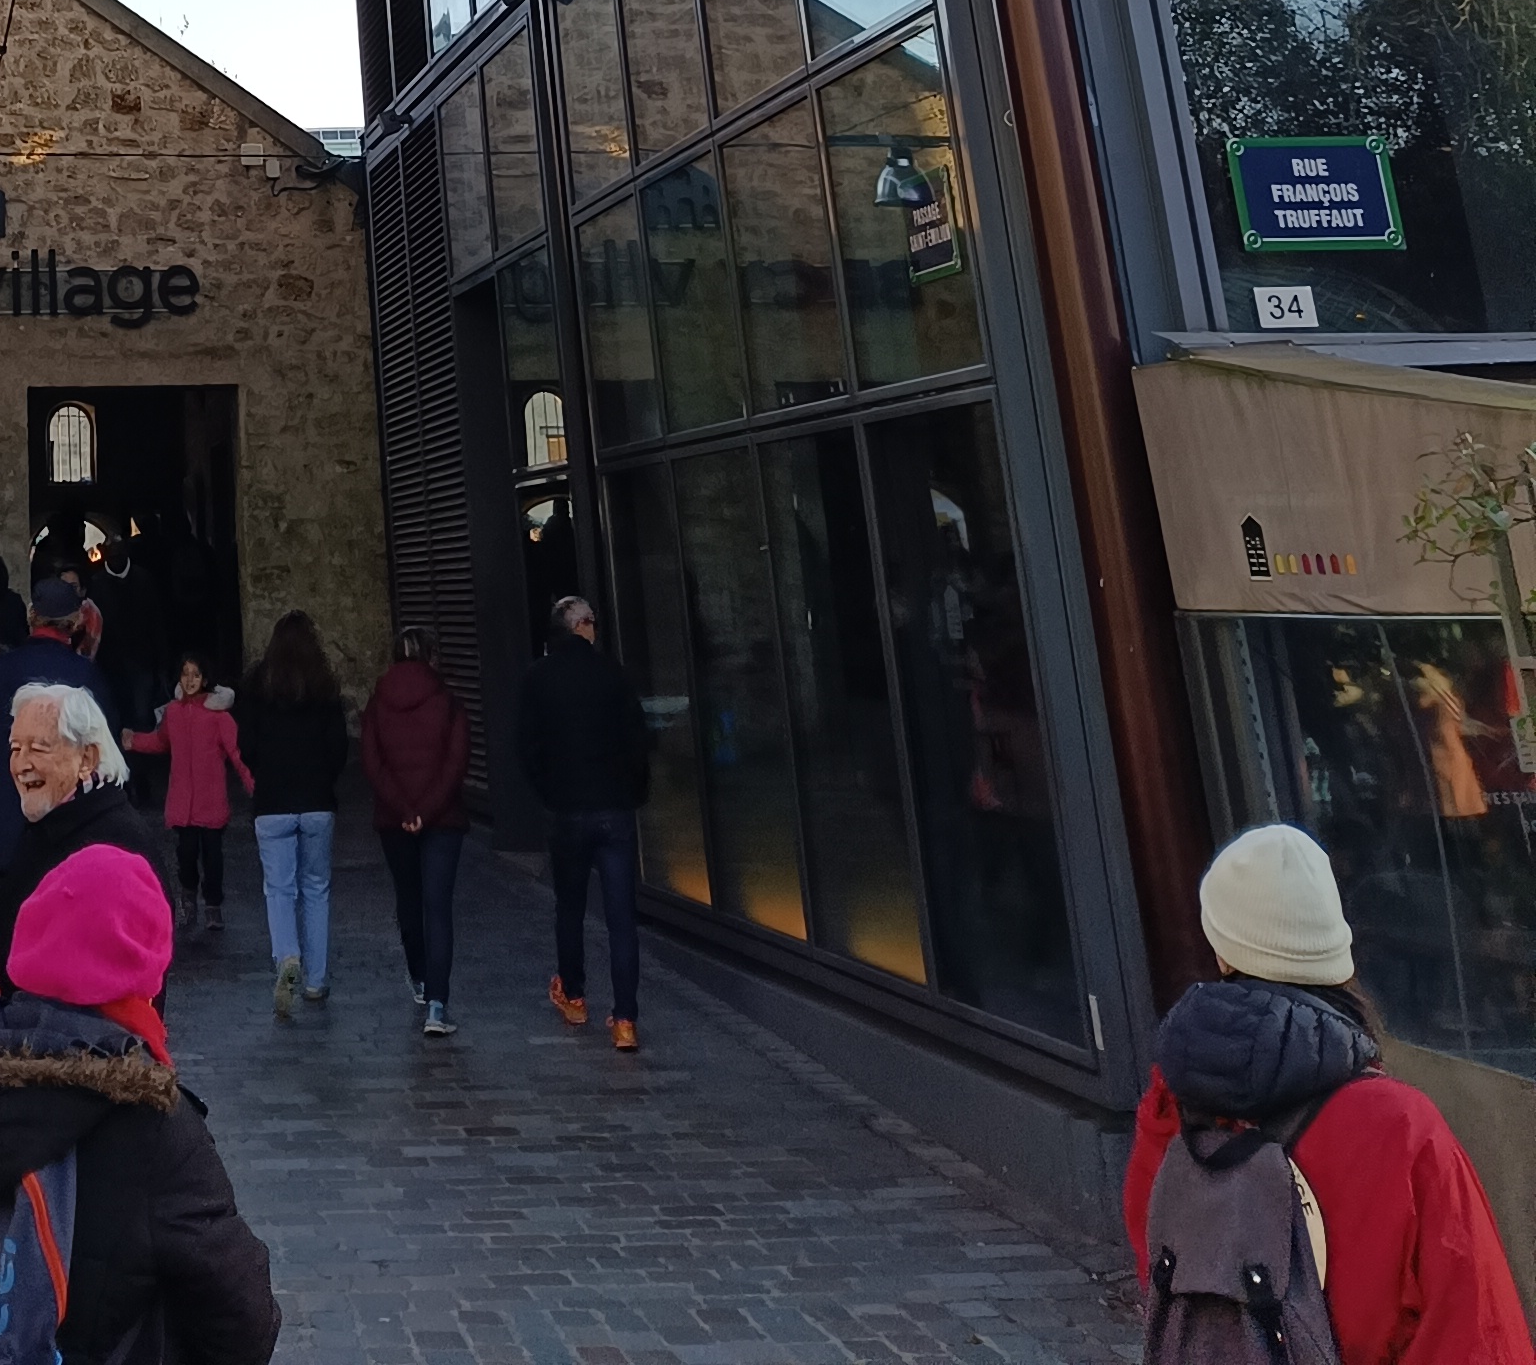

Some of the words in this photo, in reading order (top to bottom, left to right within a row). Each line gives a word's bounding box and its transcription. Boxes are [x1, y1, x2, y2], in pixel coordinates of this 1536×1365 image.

[1291, 158, 1329, 177] RUE
[1270, 183, 1360, 207] FRANÇOIS
[913, 201, 941, 227] PASSAGE
[1273, 209, 1364, 229] TRUFFAUT
[1267, 294, 1304, 320] 34
